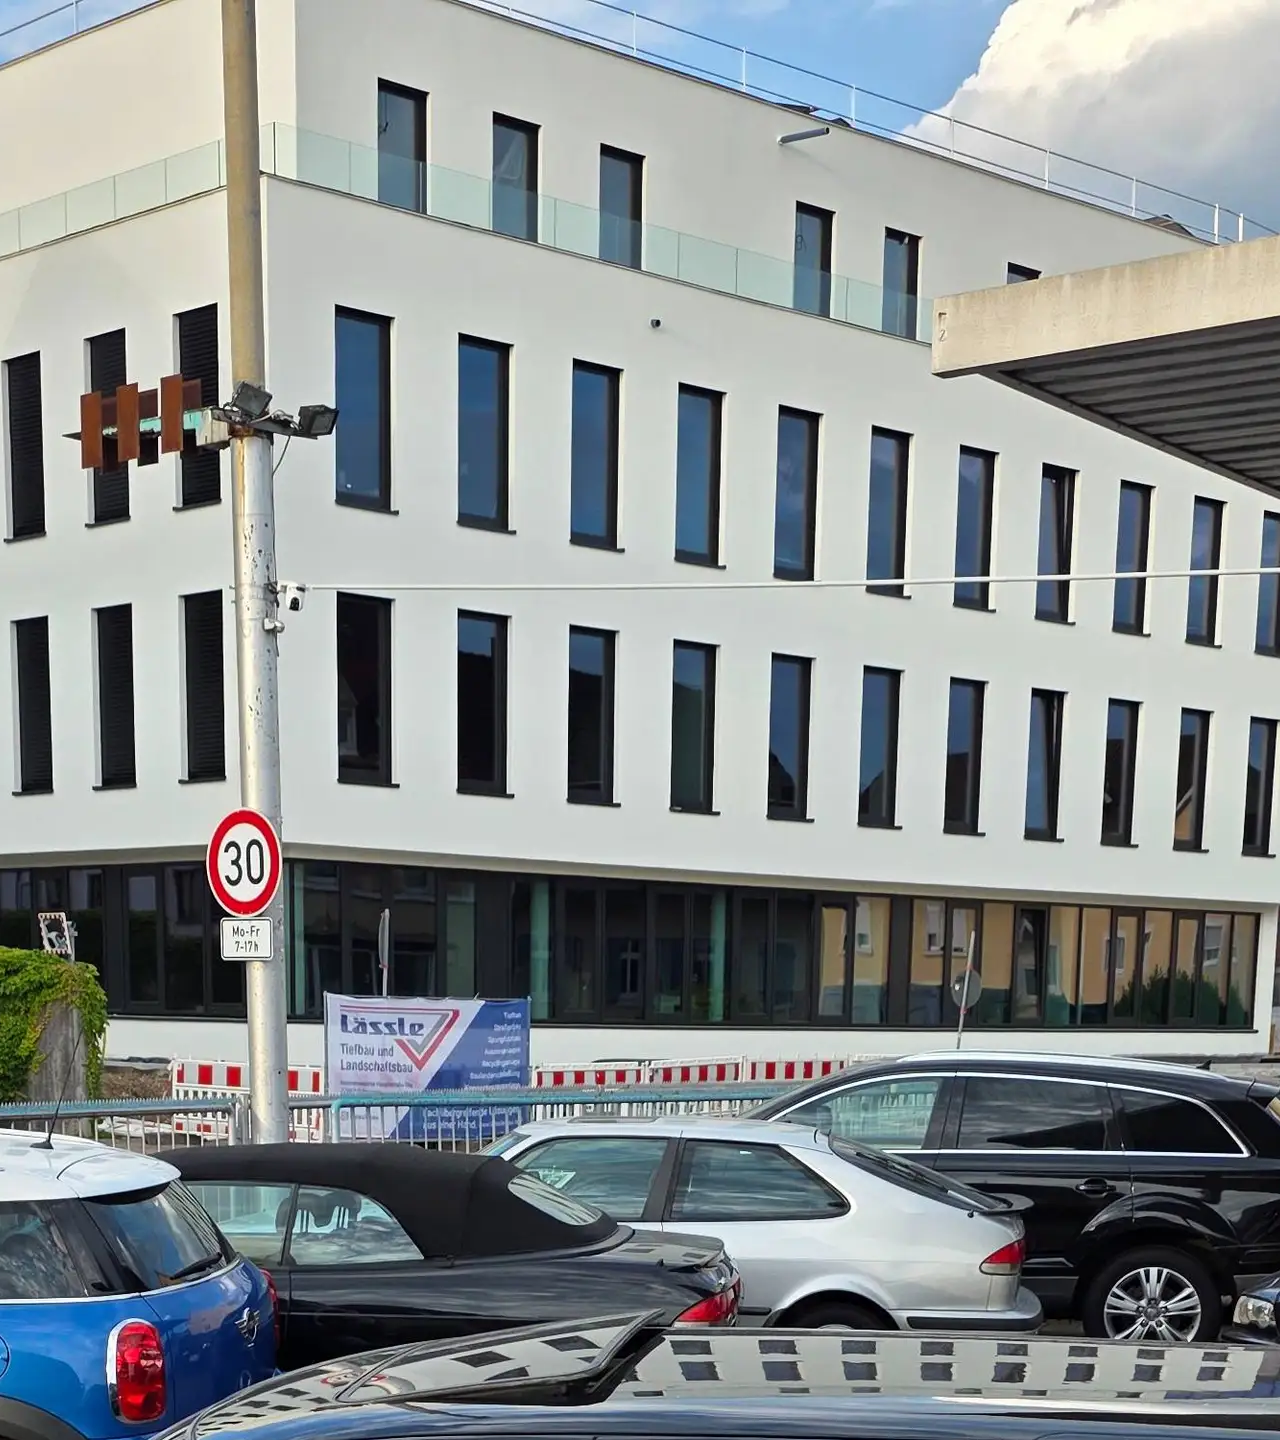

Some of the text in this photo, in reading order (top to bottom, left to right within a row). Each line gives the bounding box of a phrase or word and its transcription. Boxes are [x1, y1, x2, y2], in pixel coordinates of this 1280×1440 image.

[223, 838, 265, 887] 30
[232, 925, 261, 938] Mo-Fr
[340, 1014, 425, 1037] Lässle
[340, 1043, 394, 1057] Tiefbau und
[340, 1059, 414, 1074] Landschaftsbau
